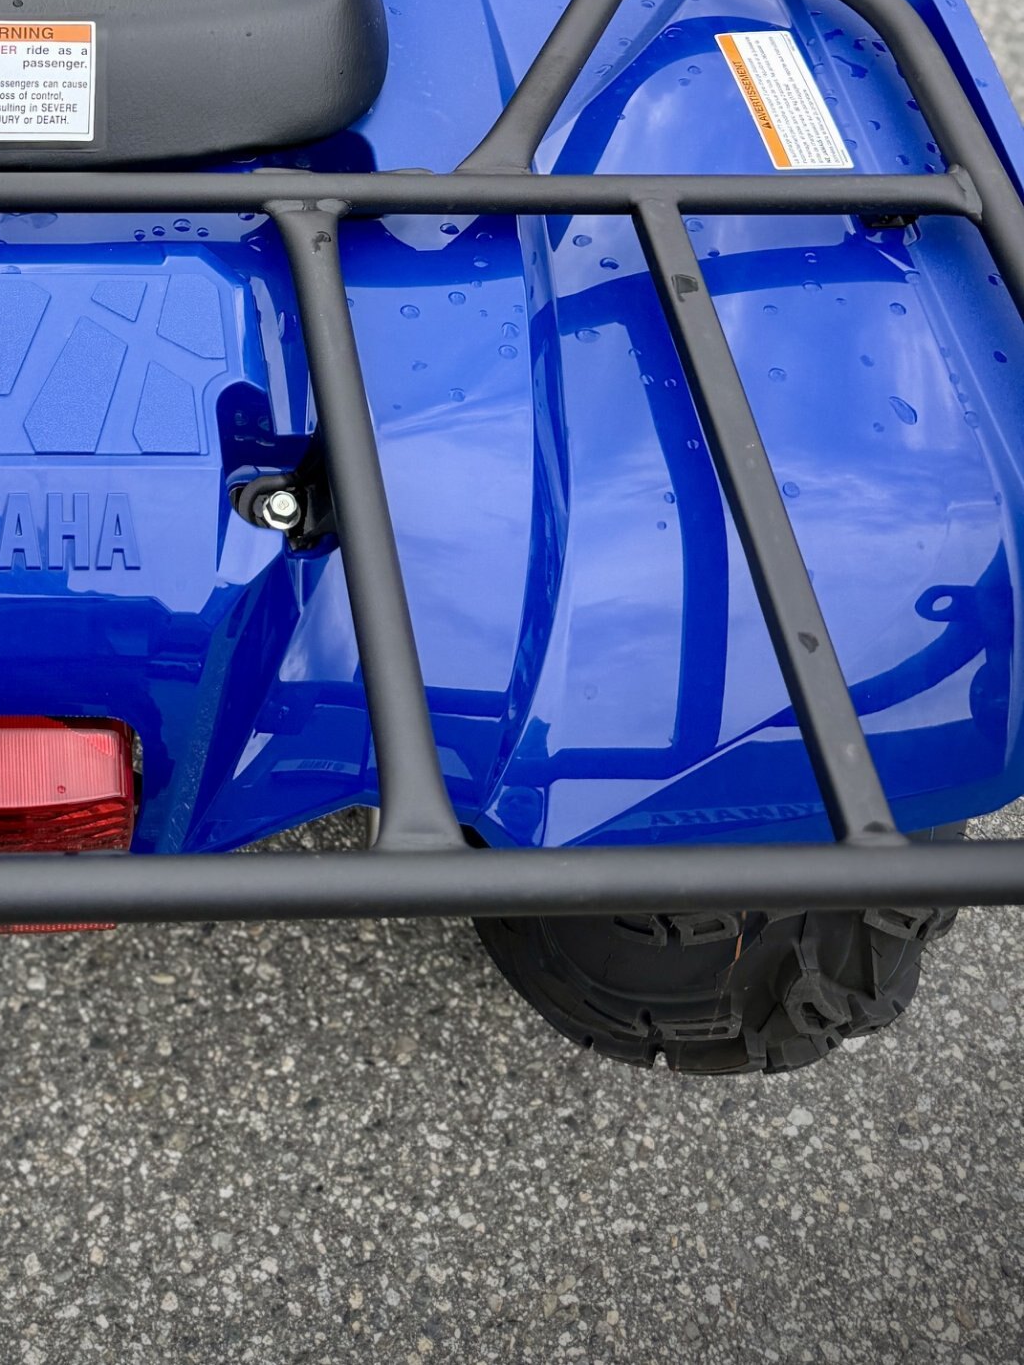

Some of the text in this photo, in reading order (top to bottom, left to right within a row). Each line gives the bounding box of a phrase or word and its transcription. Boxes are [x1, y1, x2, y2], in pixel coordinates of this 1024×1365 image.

[26, 46, 49, 55] ride
[23, 59, 88, 70] passenger.
[43, 80, 59, 88] can
[732, 61, 767, 120] AVERTISSEMENT
[19, 91, 28, 100] of
[31, 91, 64, 101] control,
[29, 103, 38, 112] in
[41, 103, 77, 112] SEVERE
[37, 115, 69, 124] DEATH.
